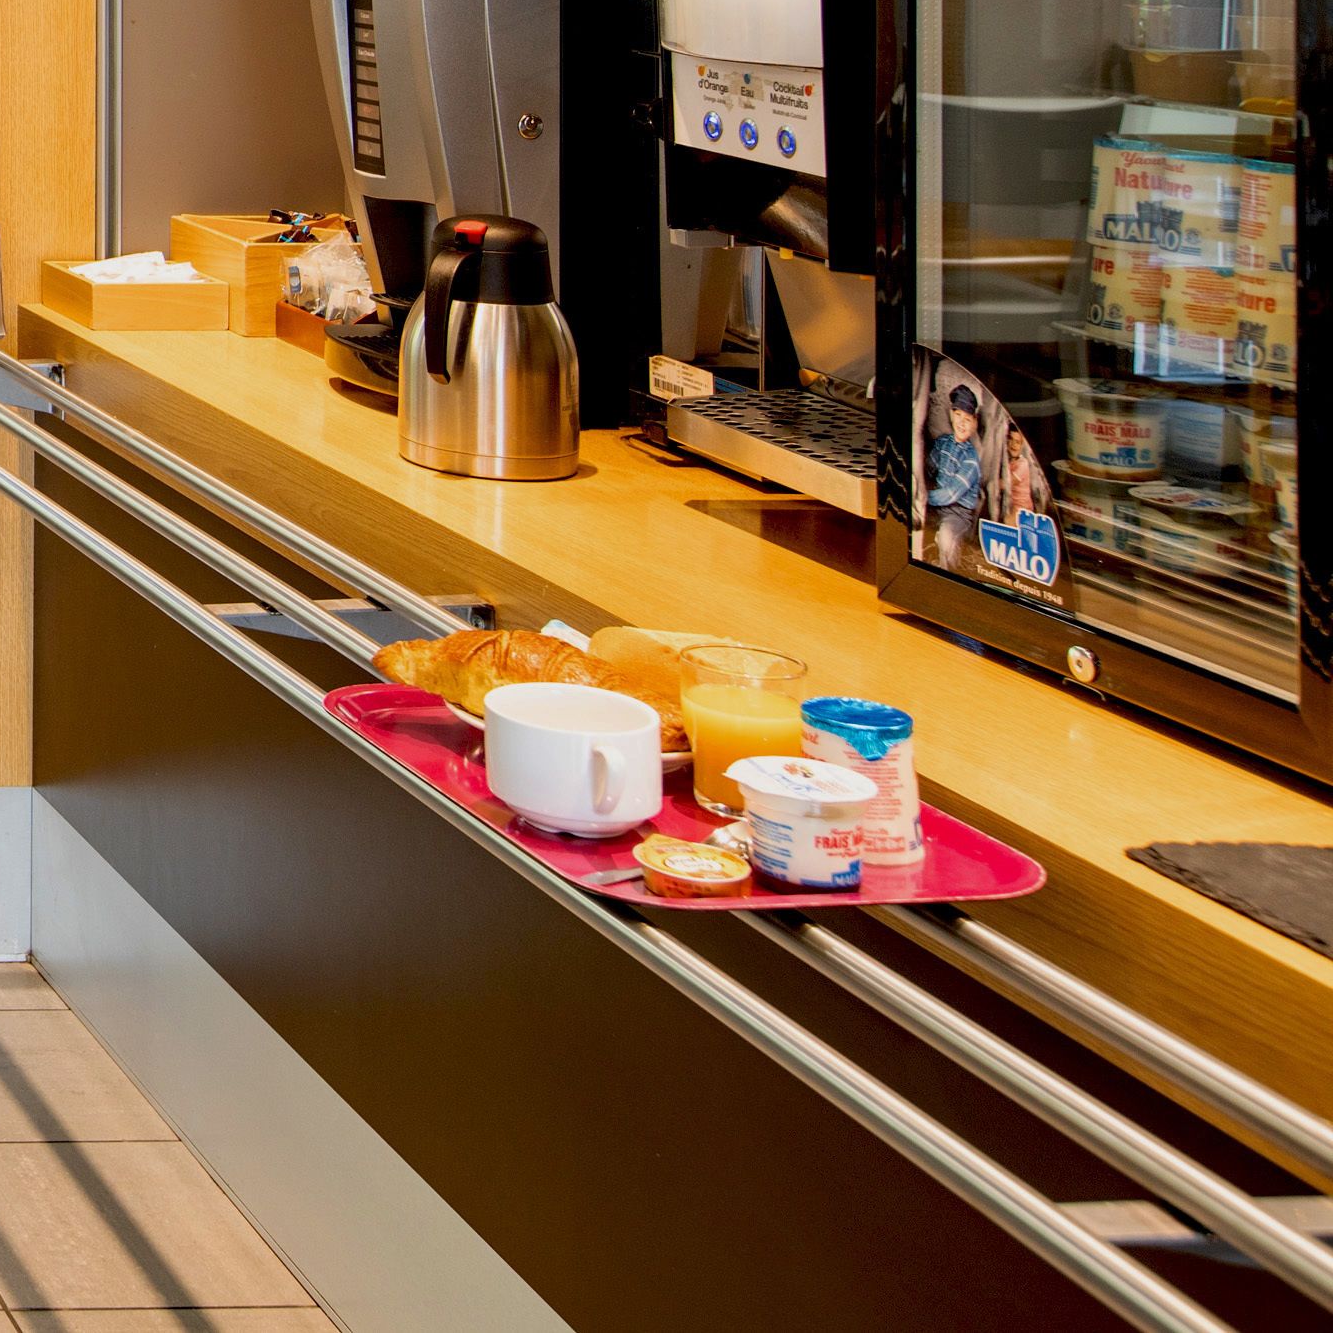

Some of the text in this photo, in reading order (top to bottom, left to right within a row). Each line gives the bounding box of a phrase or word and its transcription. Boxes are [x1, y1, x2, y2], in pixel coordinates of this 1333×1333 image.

[706, 68, 719, 80] Jus
[698, 78, 729, 95] d'Orange
[740, 86, 755, 98] Eau
[773, 81, 805, 97] Cocktail
[770, 93, 809, 110] Multifruits
[989, 538, 1050, 581] MALO
[976, 564, 1064, 606] Tradition depuis 1948
